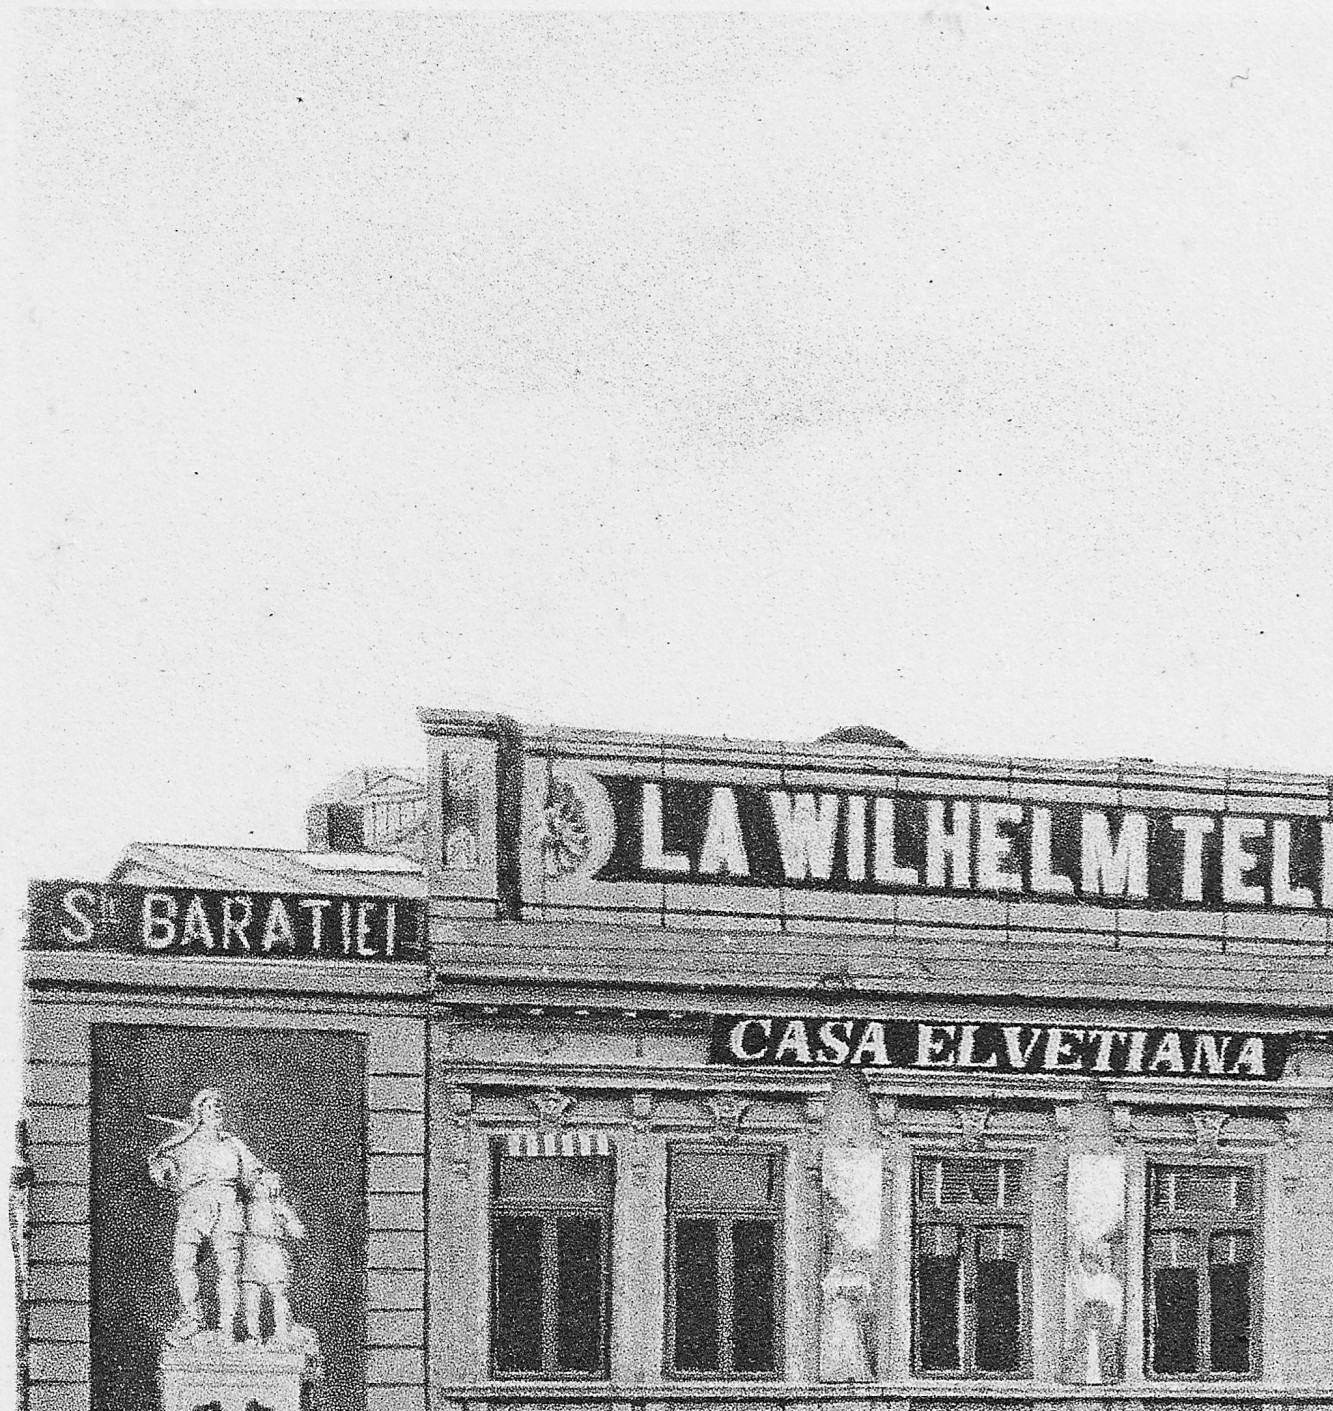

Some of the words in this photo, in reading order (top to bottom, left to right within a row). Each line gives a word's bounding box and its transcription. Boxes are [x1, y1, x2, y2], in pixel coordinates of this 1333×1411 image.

[638, 782, 751, 878] LA
[769, 789, 1149, 899] WILHELM
[142, 893, 398, 957] BARATIEI
[729, 1016, 890, 1066] CASA
[913, 1022, 1267, 1077] ELVETIANA
